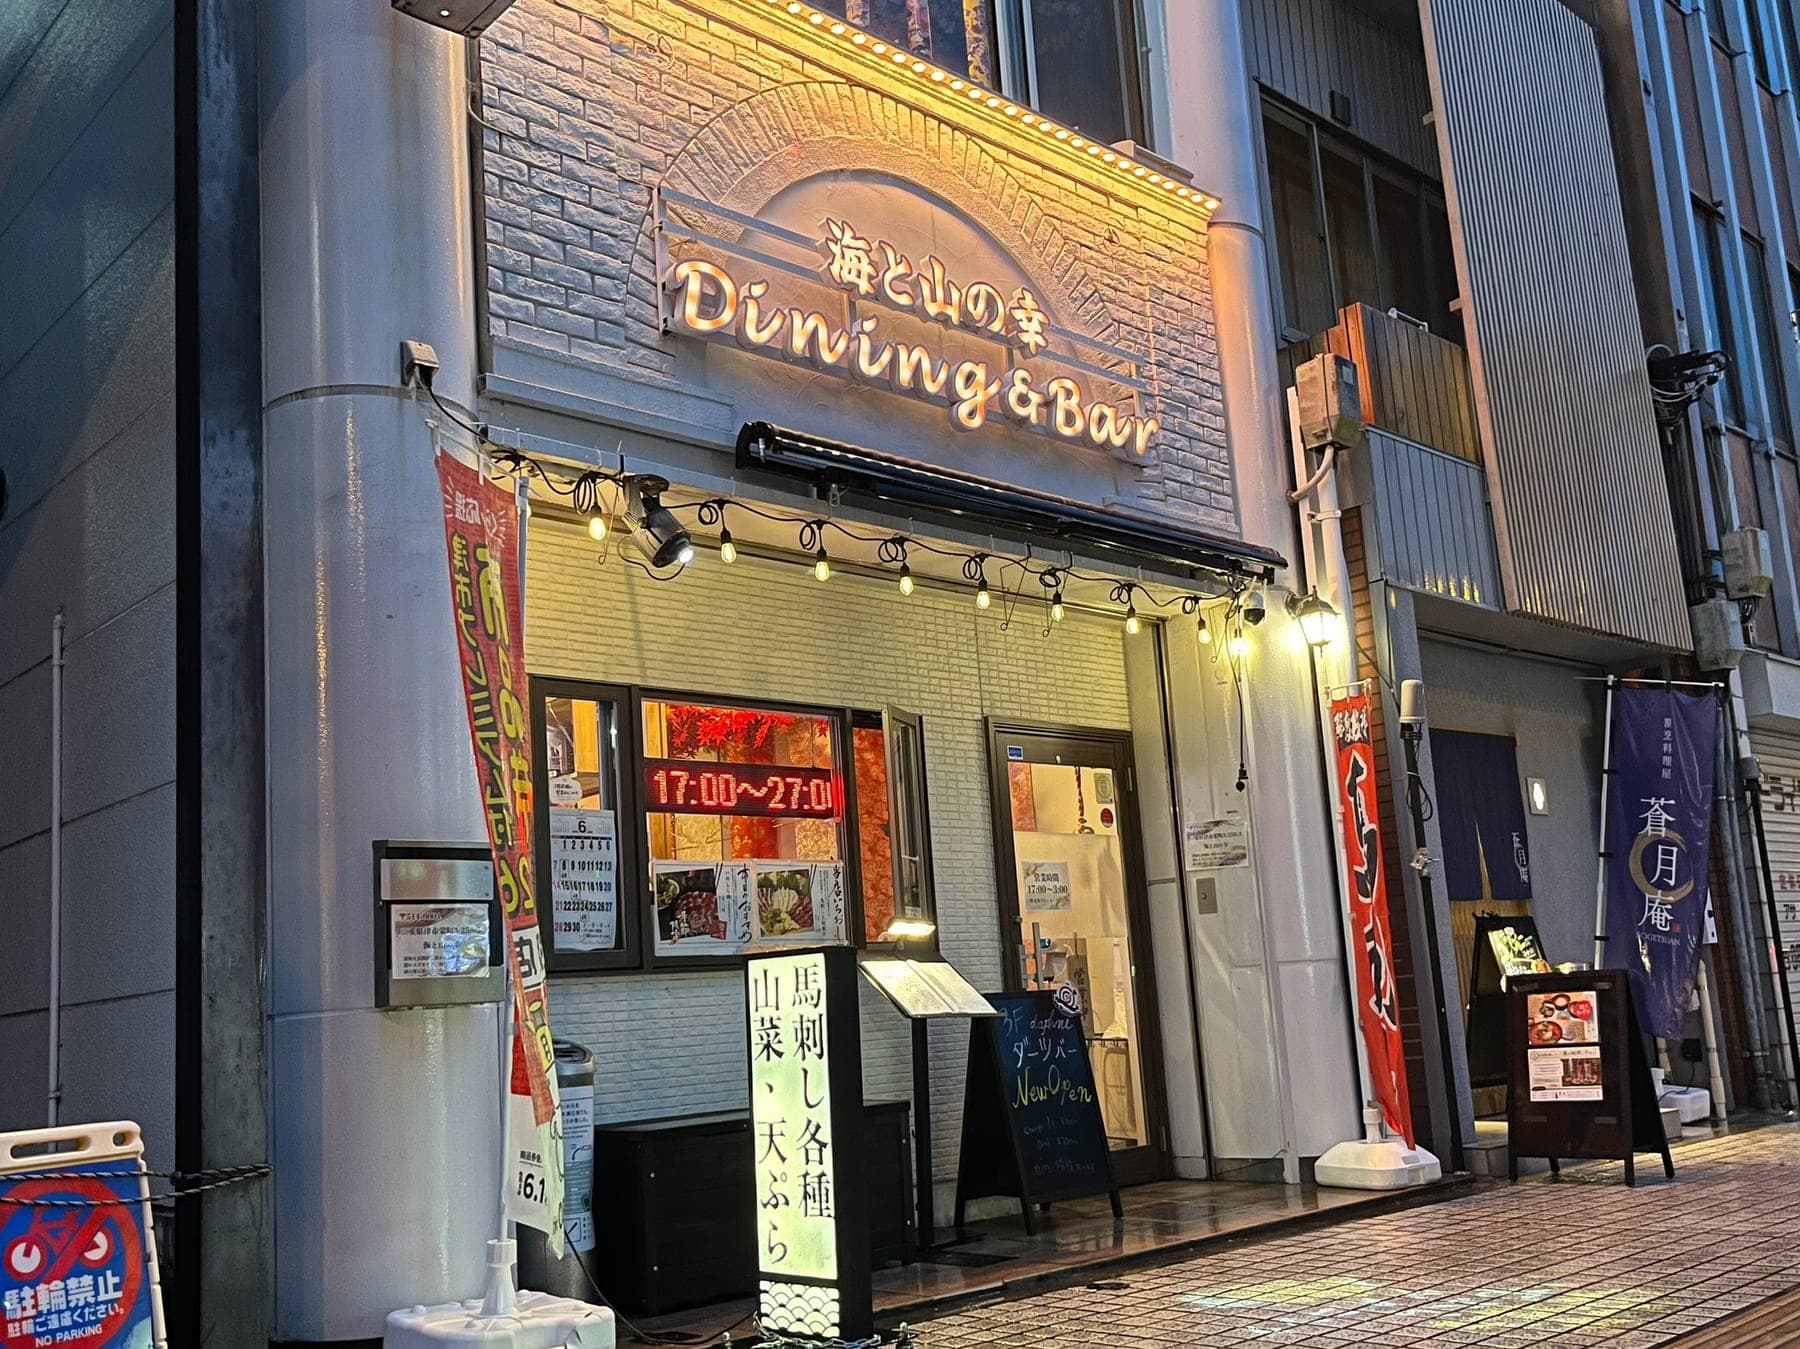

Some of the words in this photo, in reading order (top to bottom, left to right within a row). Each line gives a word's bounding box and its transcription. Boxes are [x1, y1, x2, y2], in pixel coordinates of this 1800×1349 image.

[824, 217, 1050, 358] 海と山の幸
[578, 820, 586, 833] 6
[1638, 796, 1677, 932] 蒼月庵
[753, 968, 790, 1264] 山菜、天ぷら
[791, 962, 835, 1219] 馬刺し各種
[3, 1270, 123, 1321] 駐輪禁止
[7, 1303, 125, 1338] 駐輪ご遠慮ください。
[35, 1335, 52, 1348] NO
[56, 1323, 104, 1343] PARKING
